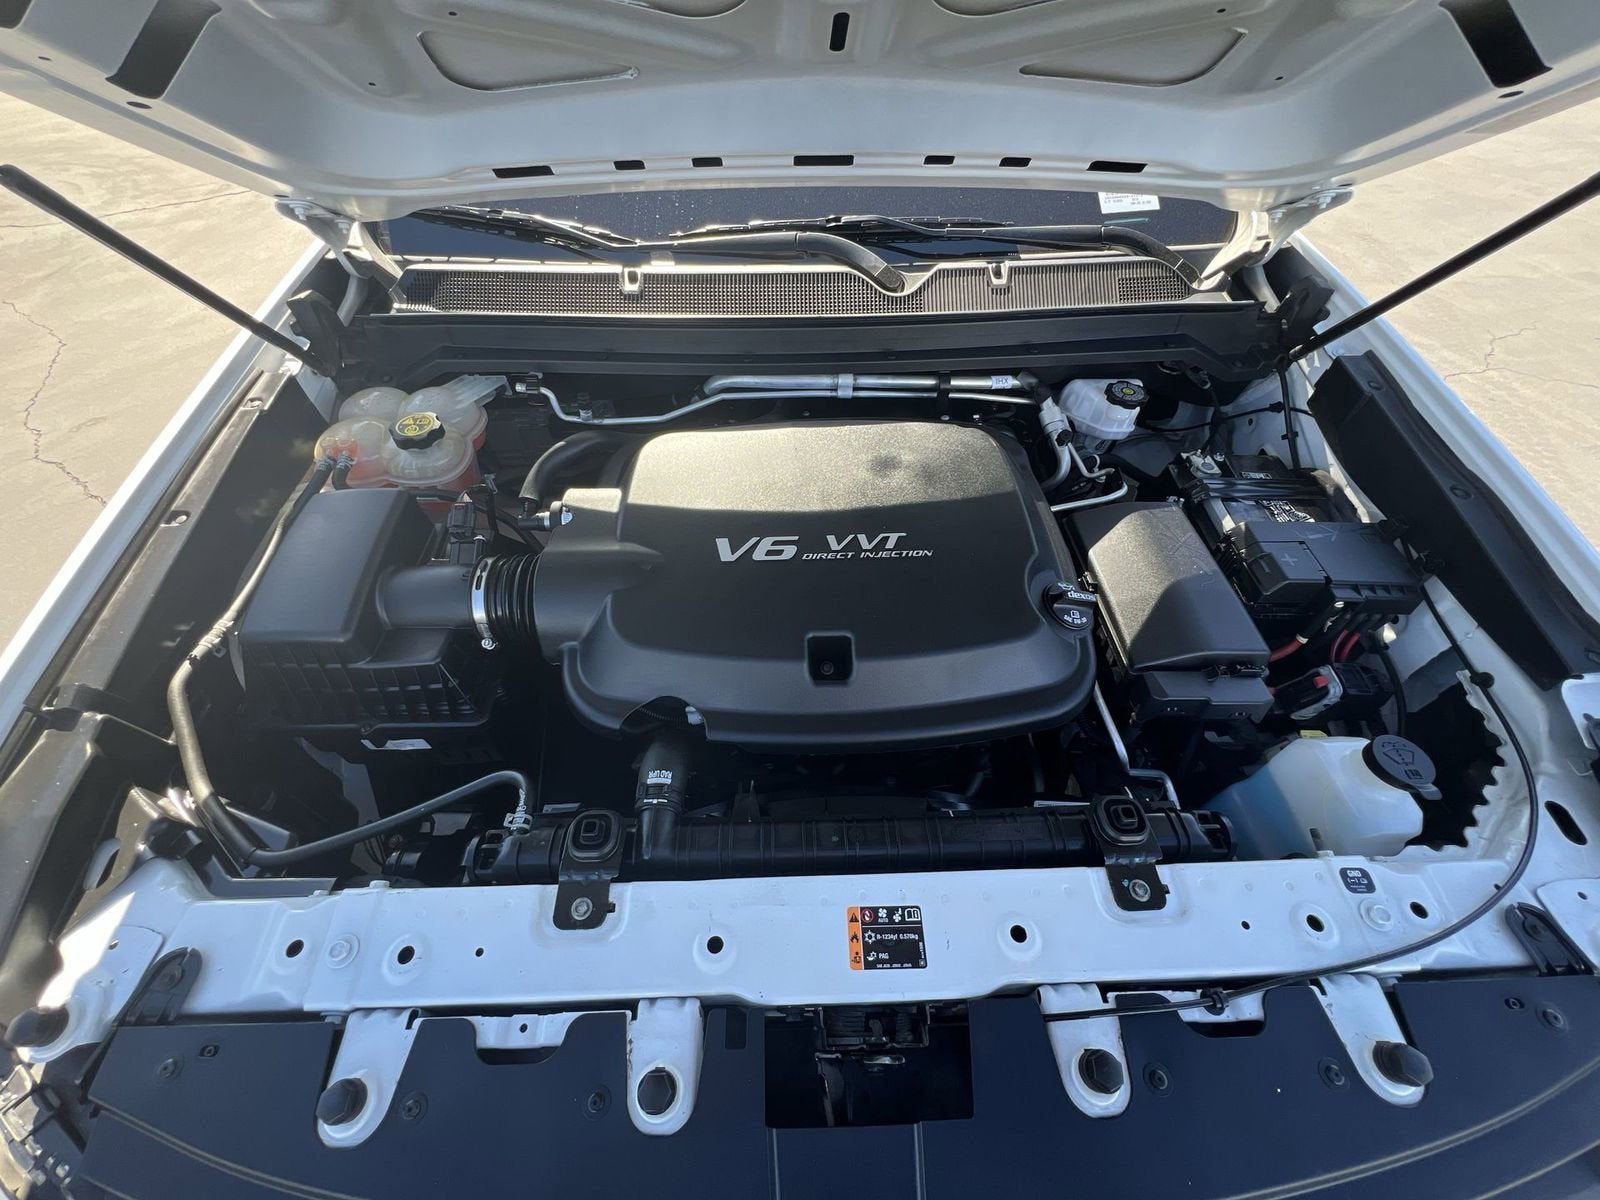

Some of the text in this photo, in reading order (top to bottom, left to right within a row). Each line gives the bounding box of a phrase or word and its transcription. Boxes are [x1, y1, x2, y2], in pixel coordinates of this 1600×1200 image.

[715, 535, 800, 562] V6
[826, 532, 907, 551] VVT
[802, 549, 934, 561] DIRECT INJECTION
[660, 770, 673, 779] RAD
